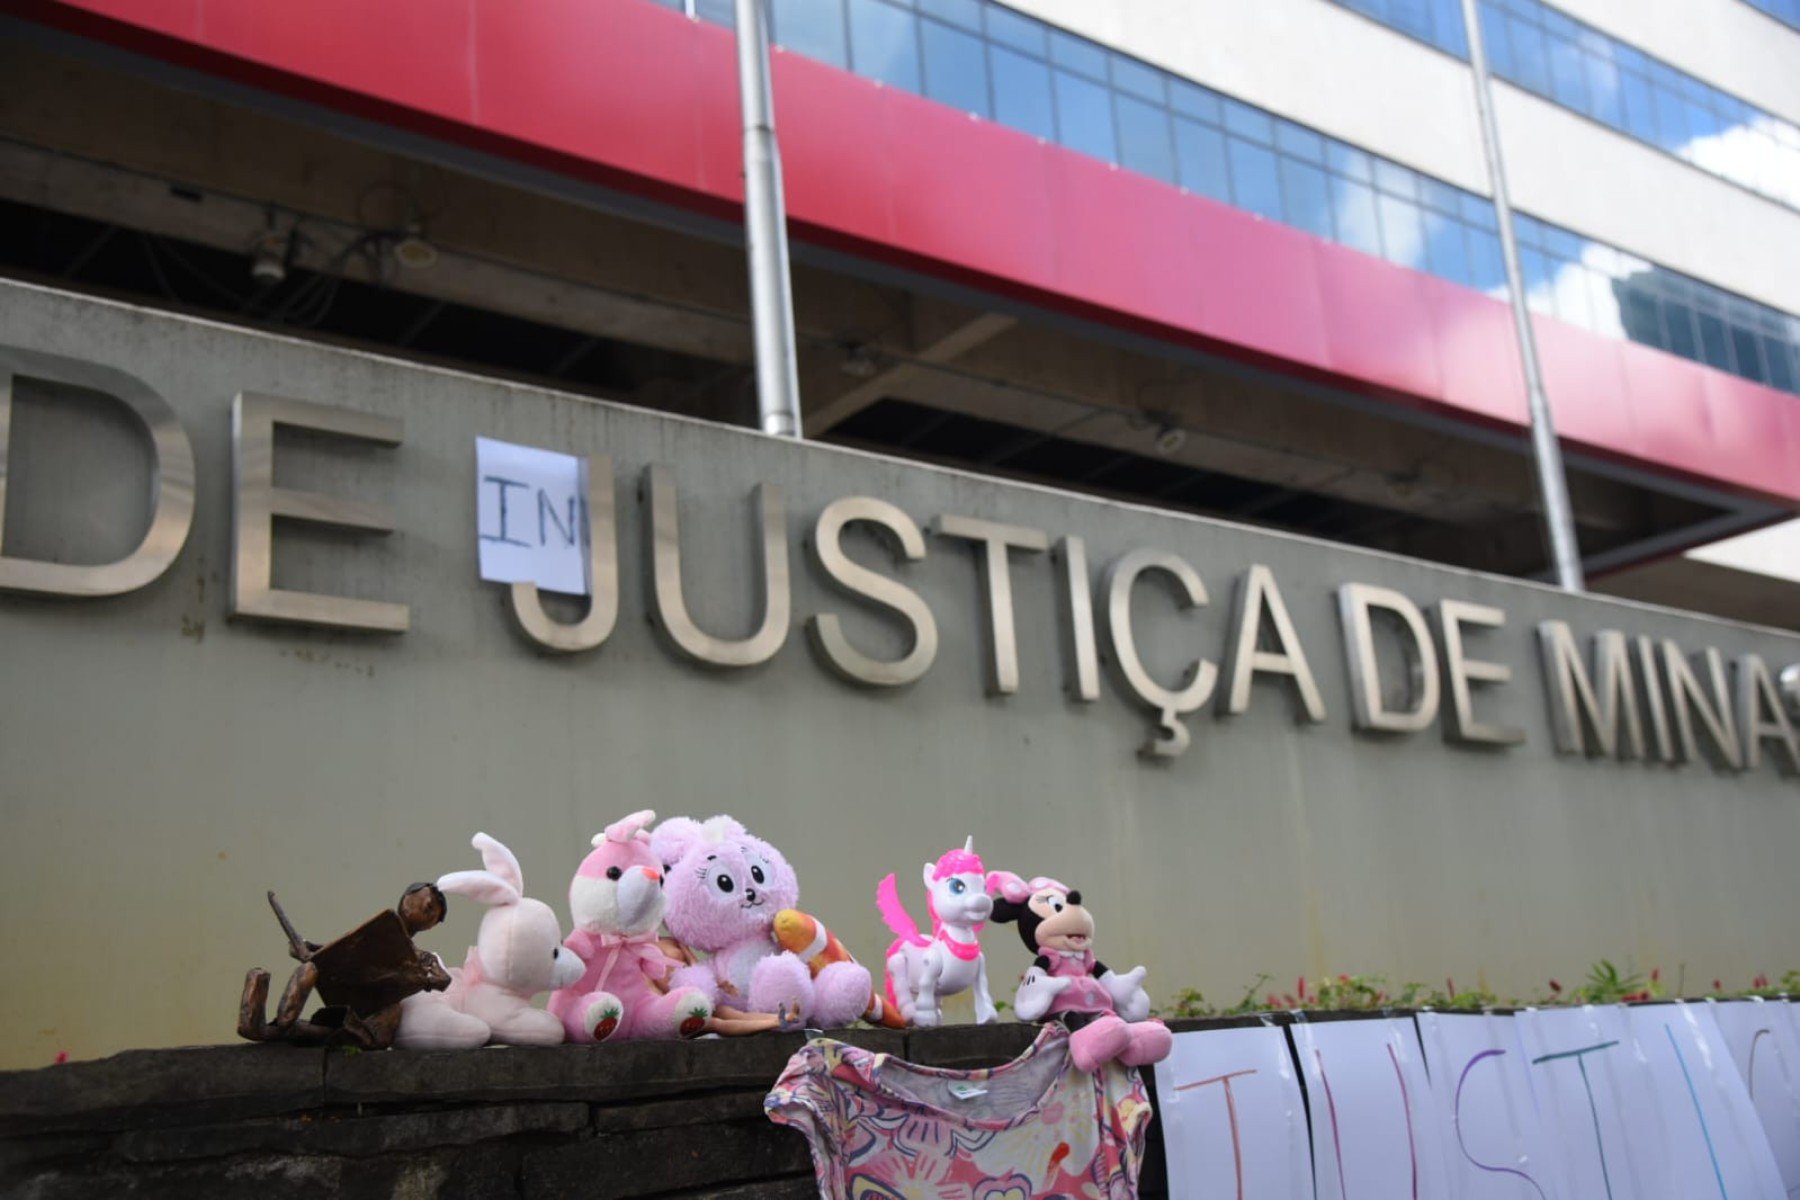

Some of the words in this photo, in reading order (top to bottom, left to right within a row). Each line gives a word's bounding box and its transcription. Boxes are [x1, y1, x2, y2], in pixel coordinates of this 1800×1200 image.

[0, 345, 410, 631] DE
[510, 452, 1327, 756] JUSTIÇA
[1339, 583, 1524, 744] DE
[480, 475, 575, 547] IN
